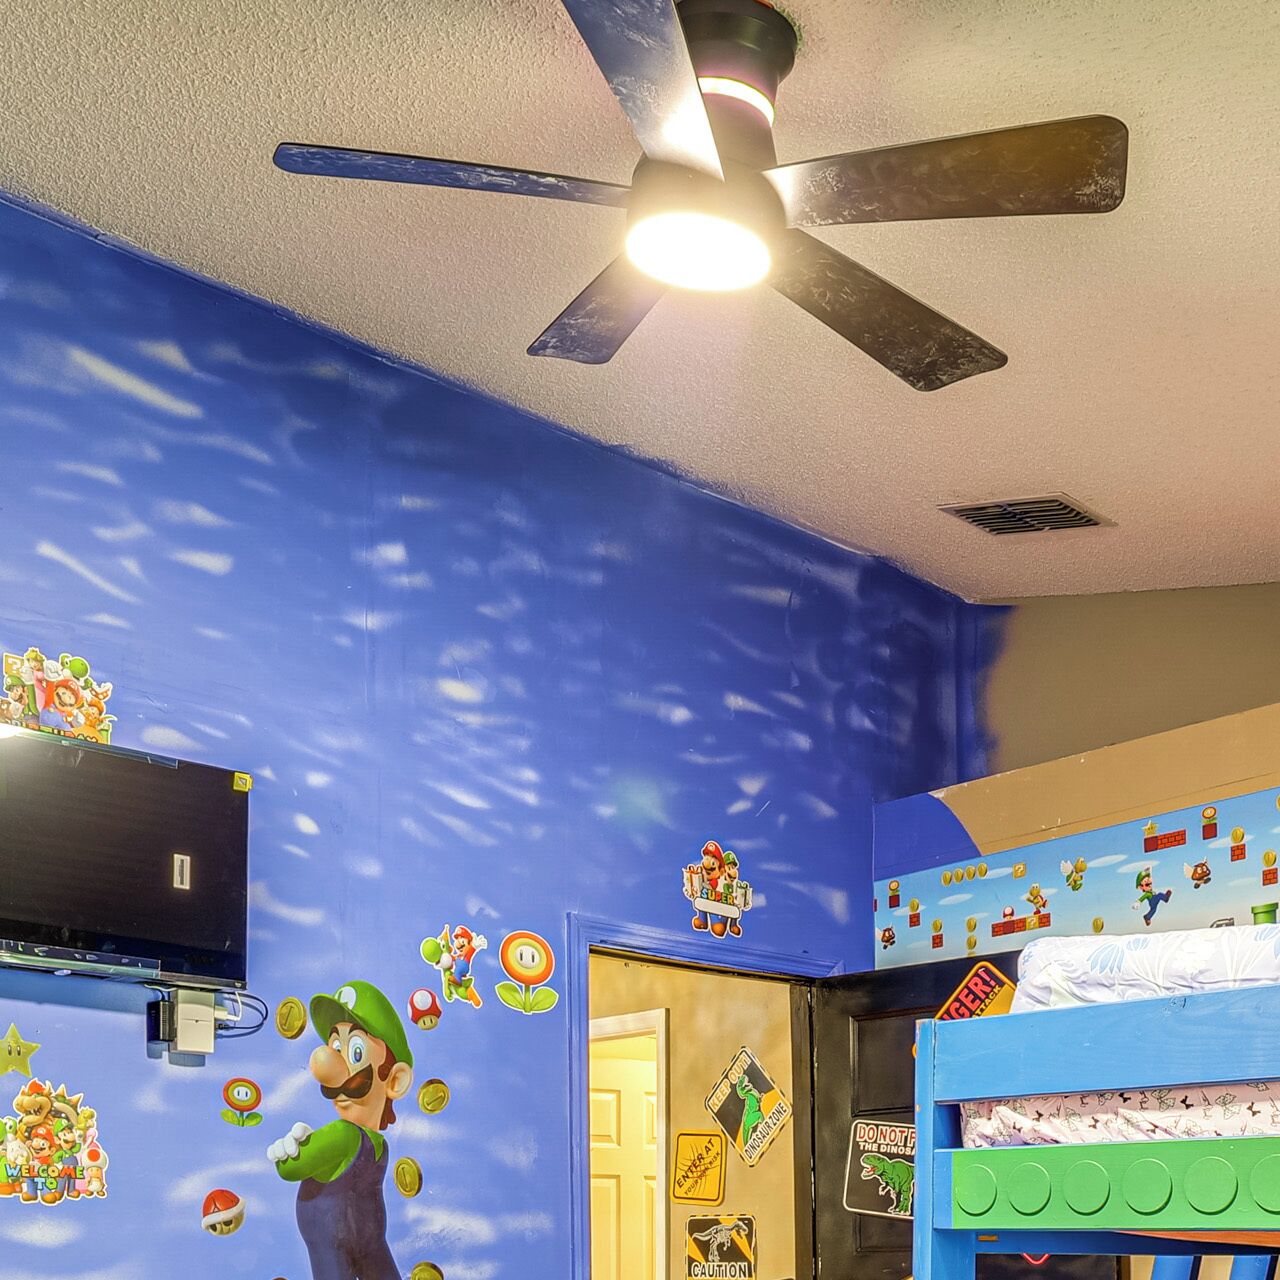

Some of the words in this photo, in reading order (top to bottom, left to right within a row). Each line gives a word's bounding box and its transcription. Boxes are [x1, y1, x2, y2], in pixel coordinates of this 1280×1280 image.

[700, 887, 736, 906] SUPER
[941, 967, 997, 1020] GER!
[708, 1078, 732, 1113] KEEP
[728, 1052, 752, 1084] OUT!
[744, 1121, 774, 1160] DINOSAUR
[768, 1102, 787, 1126] ZONE
[856, 1124, 877, 1143] DO
[877, 1126, 908, 1146] NOT
[859, 1142, 878, 1151] THE
[880, 1143, 915, 1156] DINOS
[5, 1163, 85, 1179] WELCOME
[677, 1153, 704, 1188] ENTER
[704, 1138, 715, 1155] AT
[684, 1179, 699, 1195] YOUR
[709, 1150, 721, 1166] RISK
[34, 1177, 58, 1190] TO
[691, 1262, 748, 1278] CAUTION
